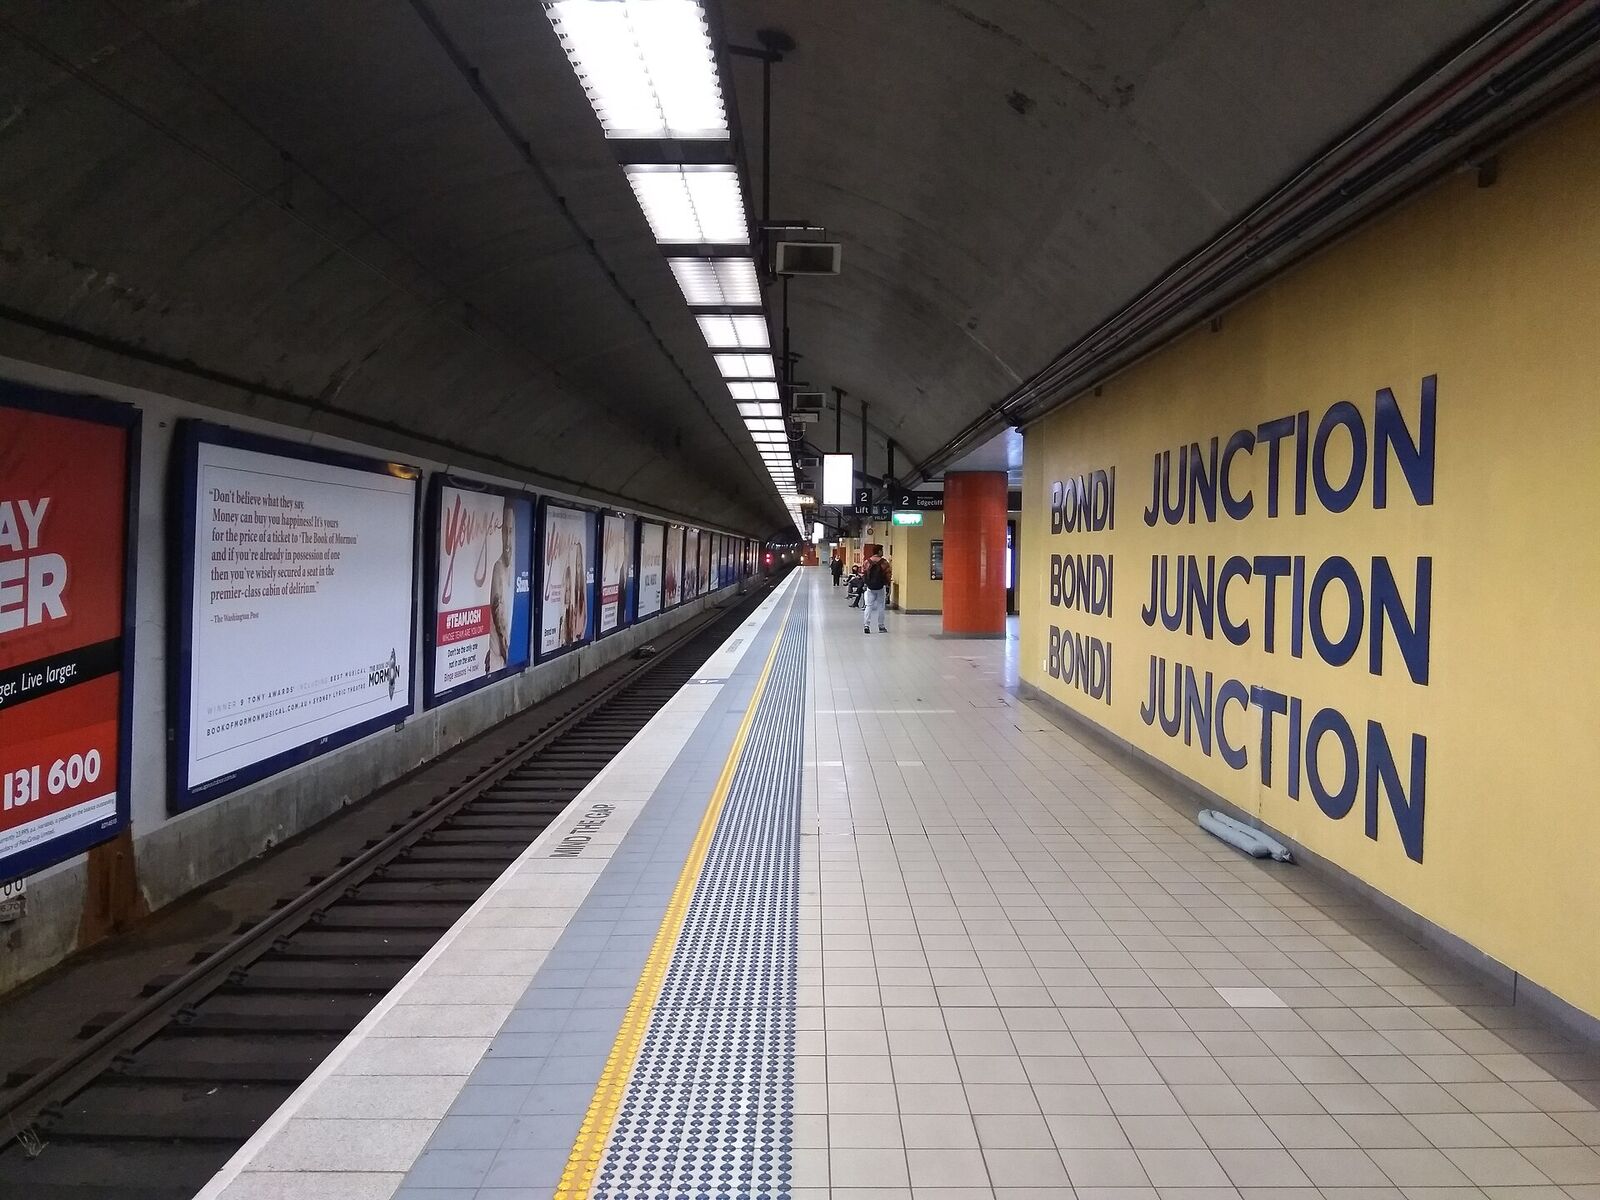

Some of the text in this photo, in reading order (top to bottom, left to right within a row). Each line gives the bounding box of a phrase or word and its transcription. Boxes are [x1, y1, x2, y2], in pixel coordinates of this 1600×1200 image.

[1051, 373, 1437, 534] BONDI JUNCTION
[236, 490, 261, 505] believe
[262, 493, 279, 507] what
[280, 495, 293, 512] they
[860, 492, 868, 502] 2
[902, 496, 943, 508] 2 Edgecliff
[212, 508, 339, 531] Money can buy you happiness! It's yours
[855, 506, 869, 514] Lift
[212, 527, 224, 541] for
[225, 528, 239, 541] the
[239, 529, 258, 545] price
[259, 530, 267, 542] of
[267, 534, 272, 542] a
[272, 530, 290, 543] ticket
[291, 533, 299, 543] to
[313, 532, 328, 544] Book
[328, 532, 335, 544] of
[211, 547, 341, 565] and if you're already in possession of one
[211, 567, 229, 581] then
[230, 566, 255, 584] you've
[255, 566, 277, 582] wisely
[277, 565, 302, 578] secured
[306, 567, 319, 577] seat
[319, 565, 325, 576] in
[325, 564, 335, 576] the
[0, 552, 67, 633] ER
[210, 585, 261, 604] premier-class
[261, 584, 281, 597] cabin
[281, 582, 289, 595] of
[1050, 554, 1432, 686] BONDI JUNCTION
[21, 672, 43, 692] Live
[46, 663, 77, 684] larger.
[247, 693, 266, 704] TONY
[330, 673, 343, 683] BEST
[345, 667, 367, 678] MUSICAL
[1049, 624, 1427, 865] BONDI JUNCTION
[4, 749, 101, 811] 131 600
[549, 804, 617, 857] MIND THE GAP
